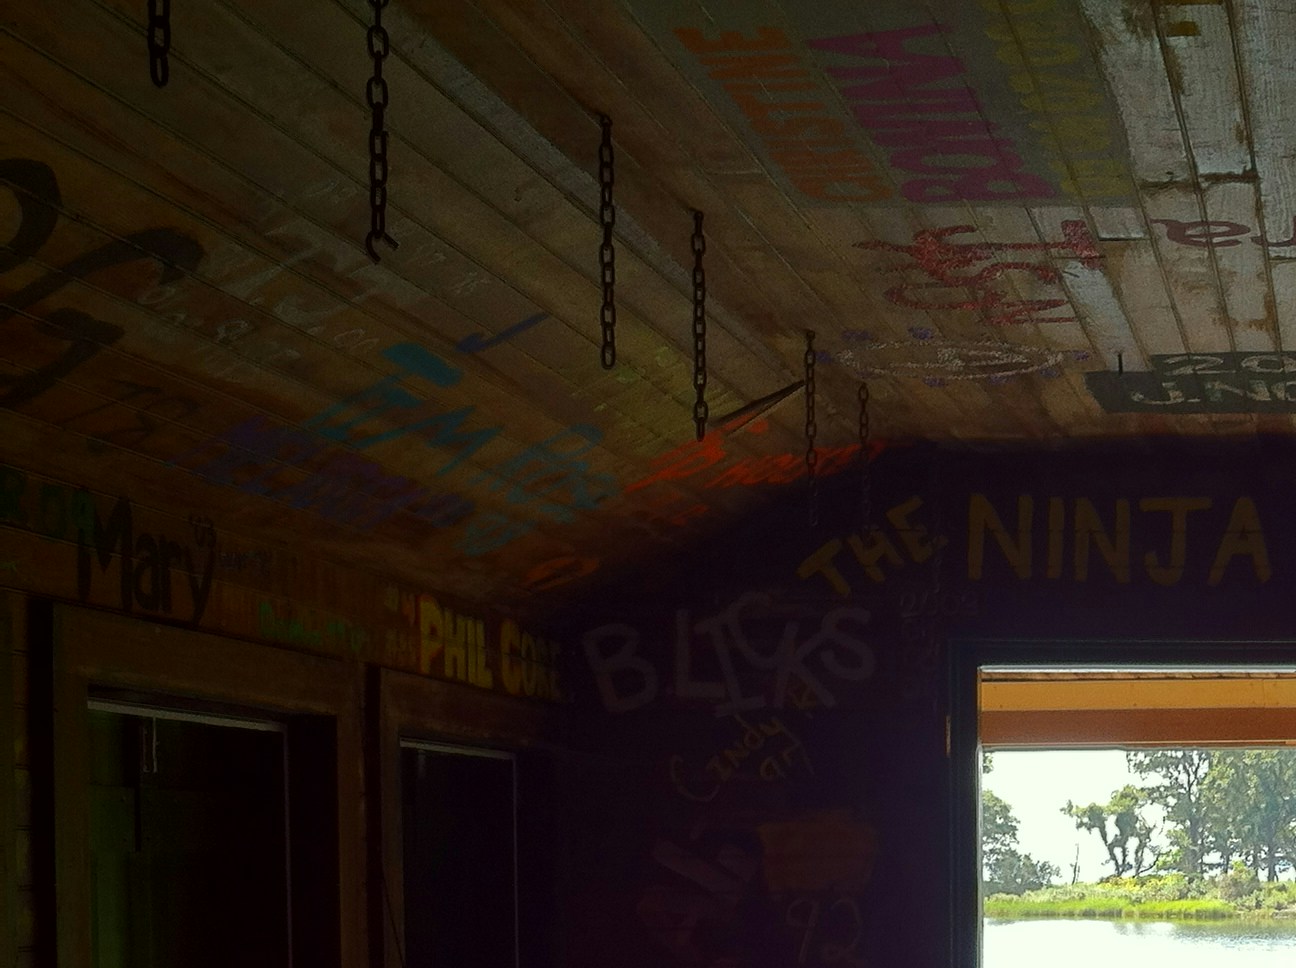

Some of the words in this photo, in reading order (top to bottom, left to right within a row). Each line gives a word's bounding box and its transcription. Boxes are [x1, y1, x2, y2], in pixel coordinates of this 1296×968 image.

[77, 496, 216, 625] Mary
[797, 497, 948, 598] THE
[966, 492, 1272, 587] NINJA
[418, 592, 493, 690] PHIL
[582, 591, 875, 719] BLICKS
